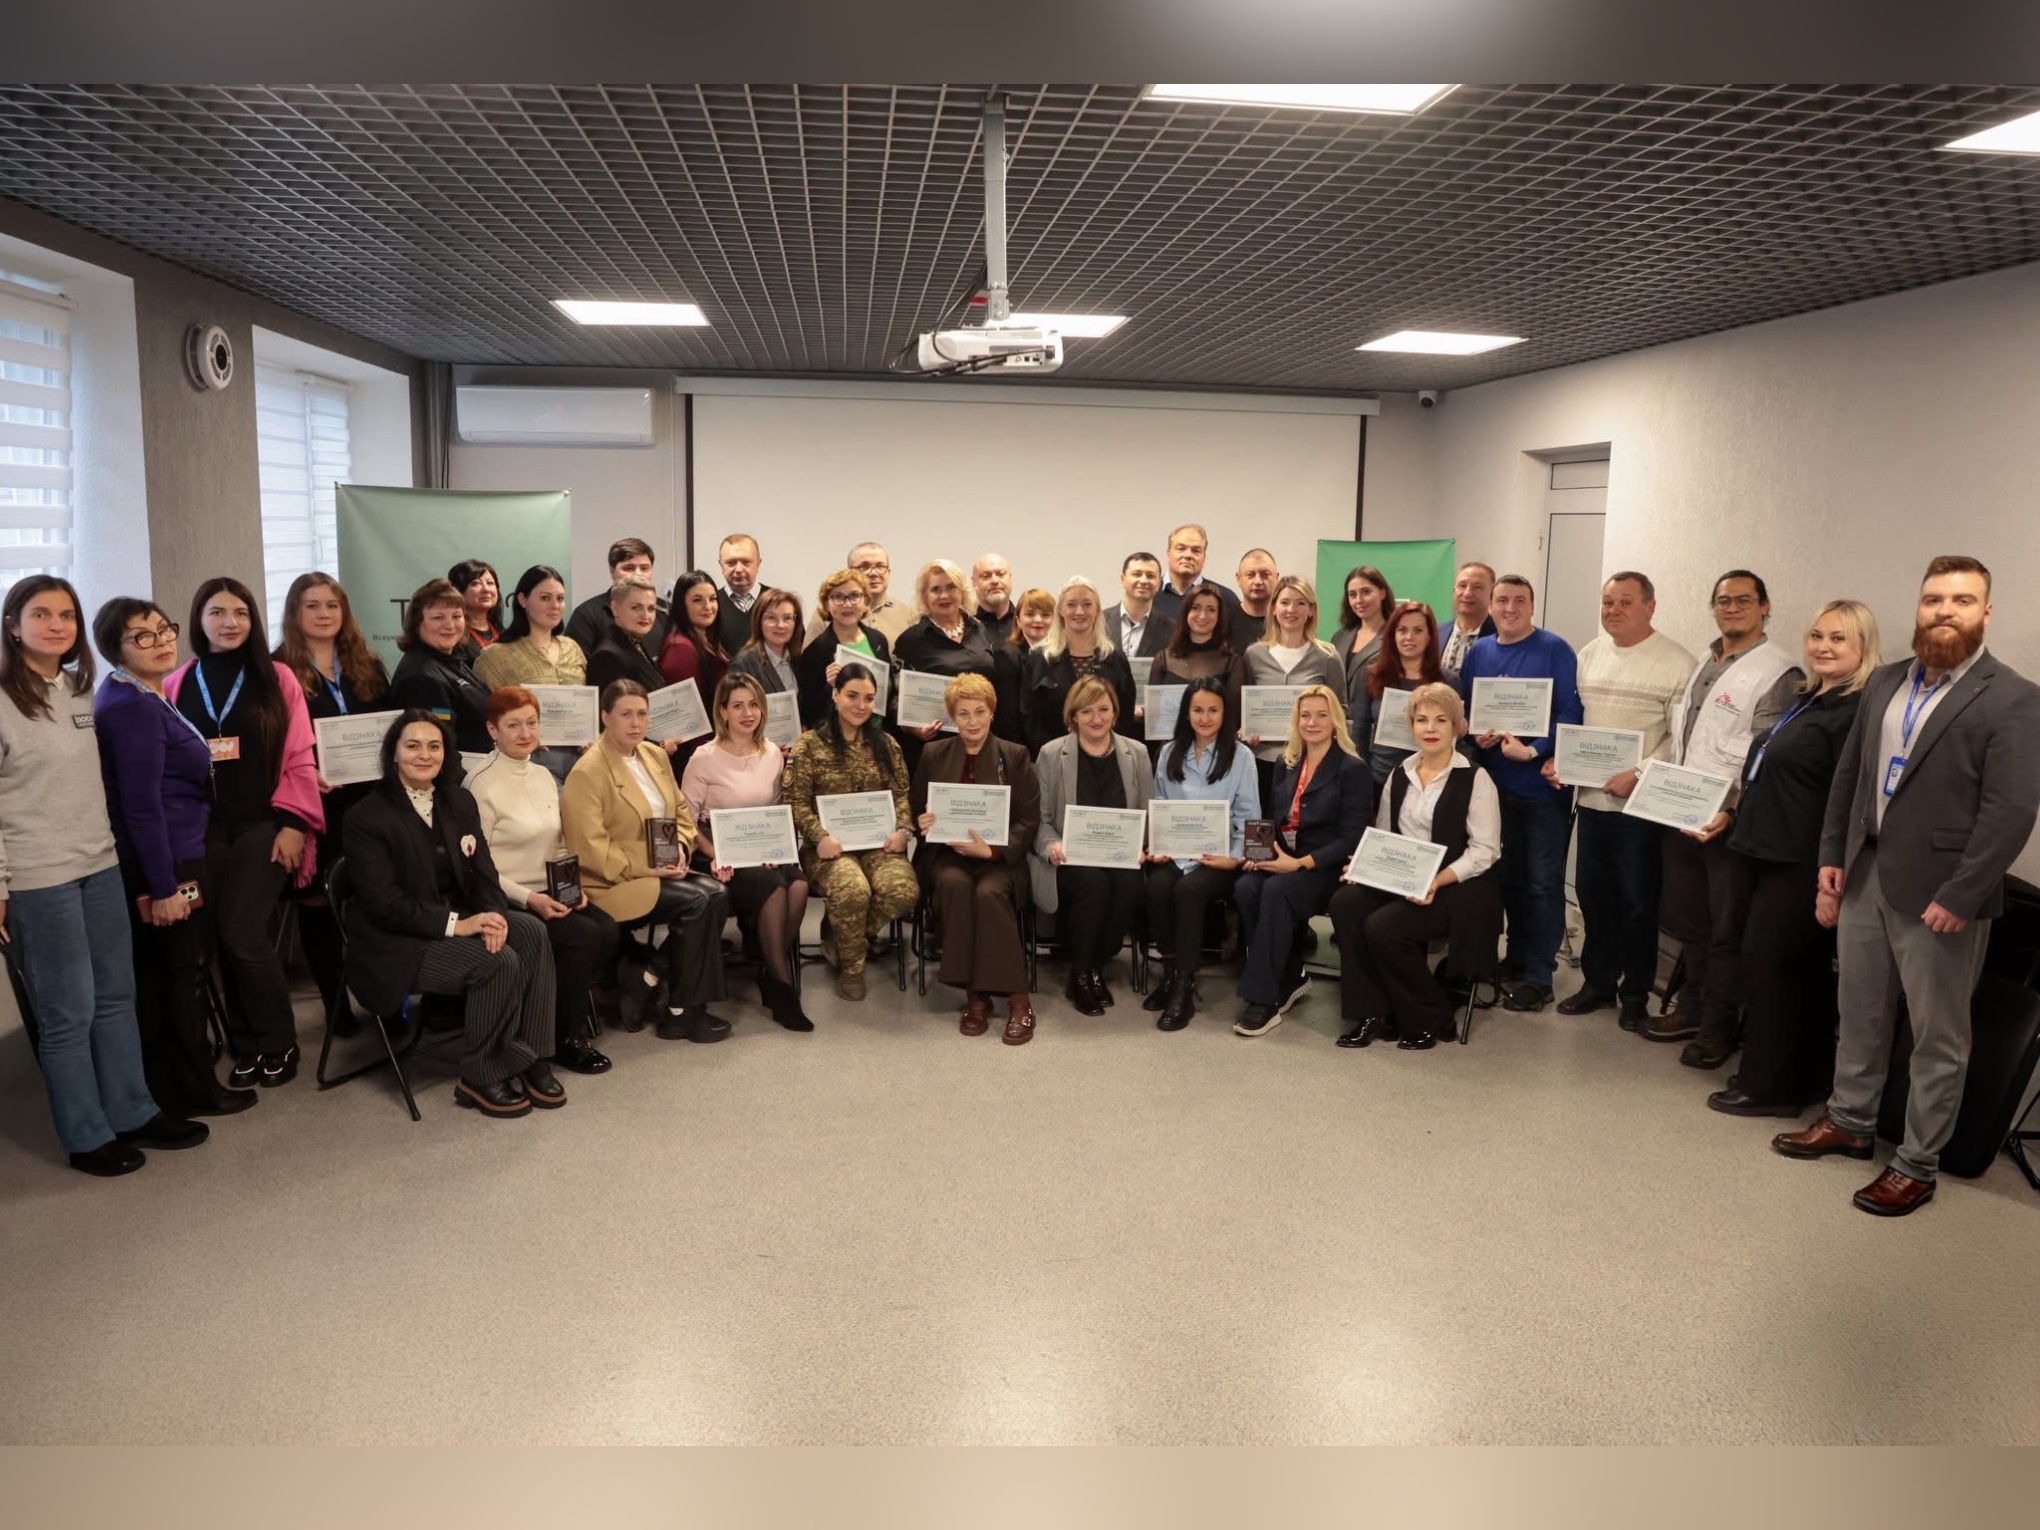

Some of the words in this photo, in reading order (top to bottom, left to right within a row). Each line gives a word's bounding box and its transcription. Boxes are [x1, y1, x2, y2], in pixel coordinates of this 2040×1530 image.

[1494, 693, 1529, 701] ВІДЗНАКА
[342, 728, 382, 741] ВІДЗНАКА
[1579, 742, 1618, 752] ВІДЗНАКА
[1663, 779, 1702, 794] ВІДЗНАКА
[950, 799, 987, 808] ВІДЗНАКА
[735, 821, 772, 831] ВІДЗНАКА
[1086, 822, 1123, 831] ВІДЗНАКА
[1381, 846, 1417, 861] ВІДЗНАКА
